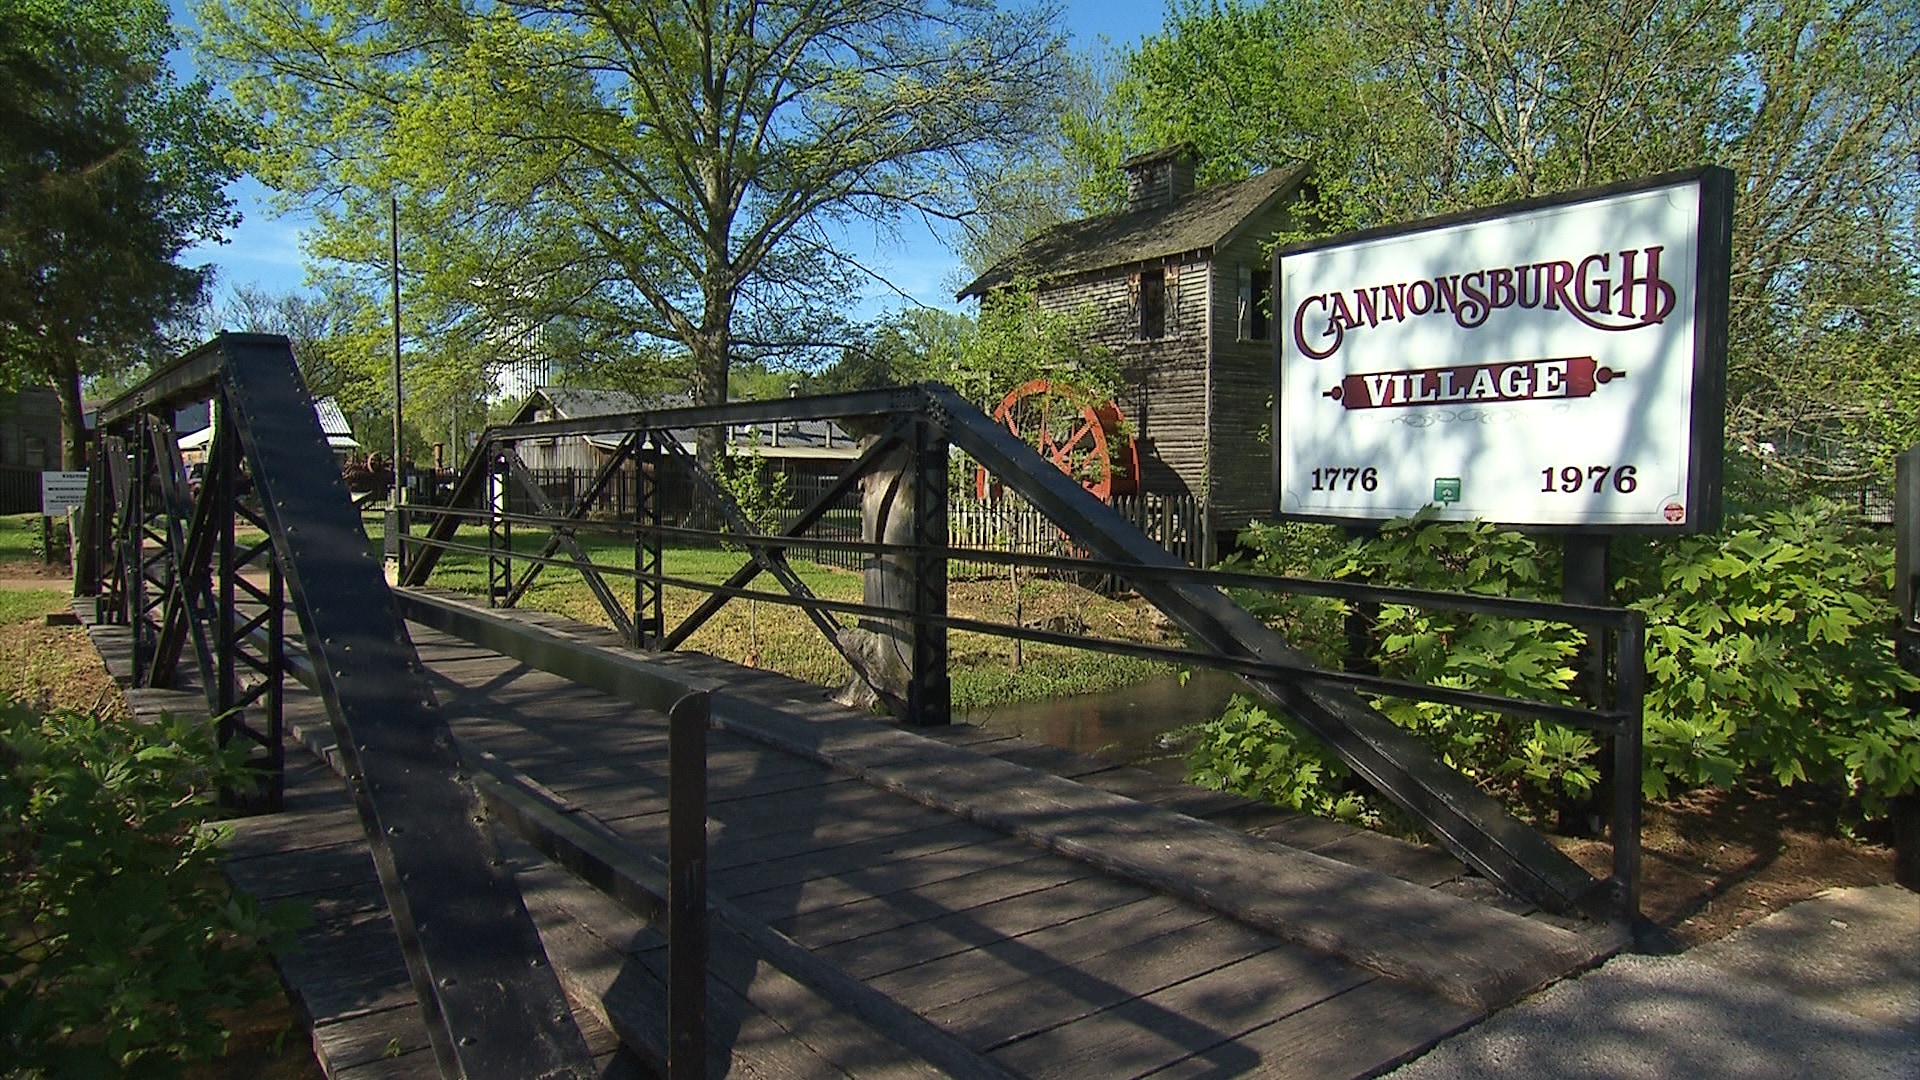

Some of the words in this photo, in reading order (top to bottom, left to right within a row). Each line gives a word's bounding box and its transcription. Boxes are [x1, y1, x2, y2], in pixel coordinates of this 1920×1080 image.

[1294, 246, 1676, 360] CANNONSBURGH
[1363, 360, 1567, 407] VILLAGE
[1311, 467, 1378, 492] 1776
[1541, 465, 1637, 494] 1976
